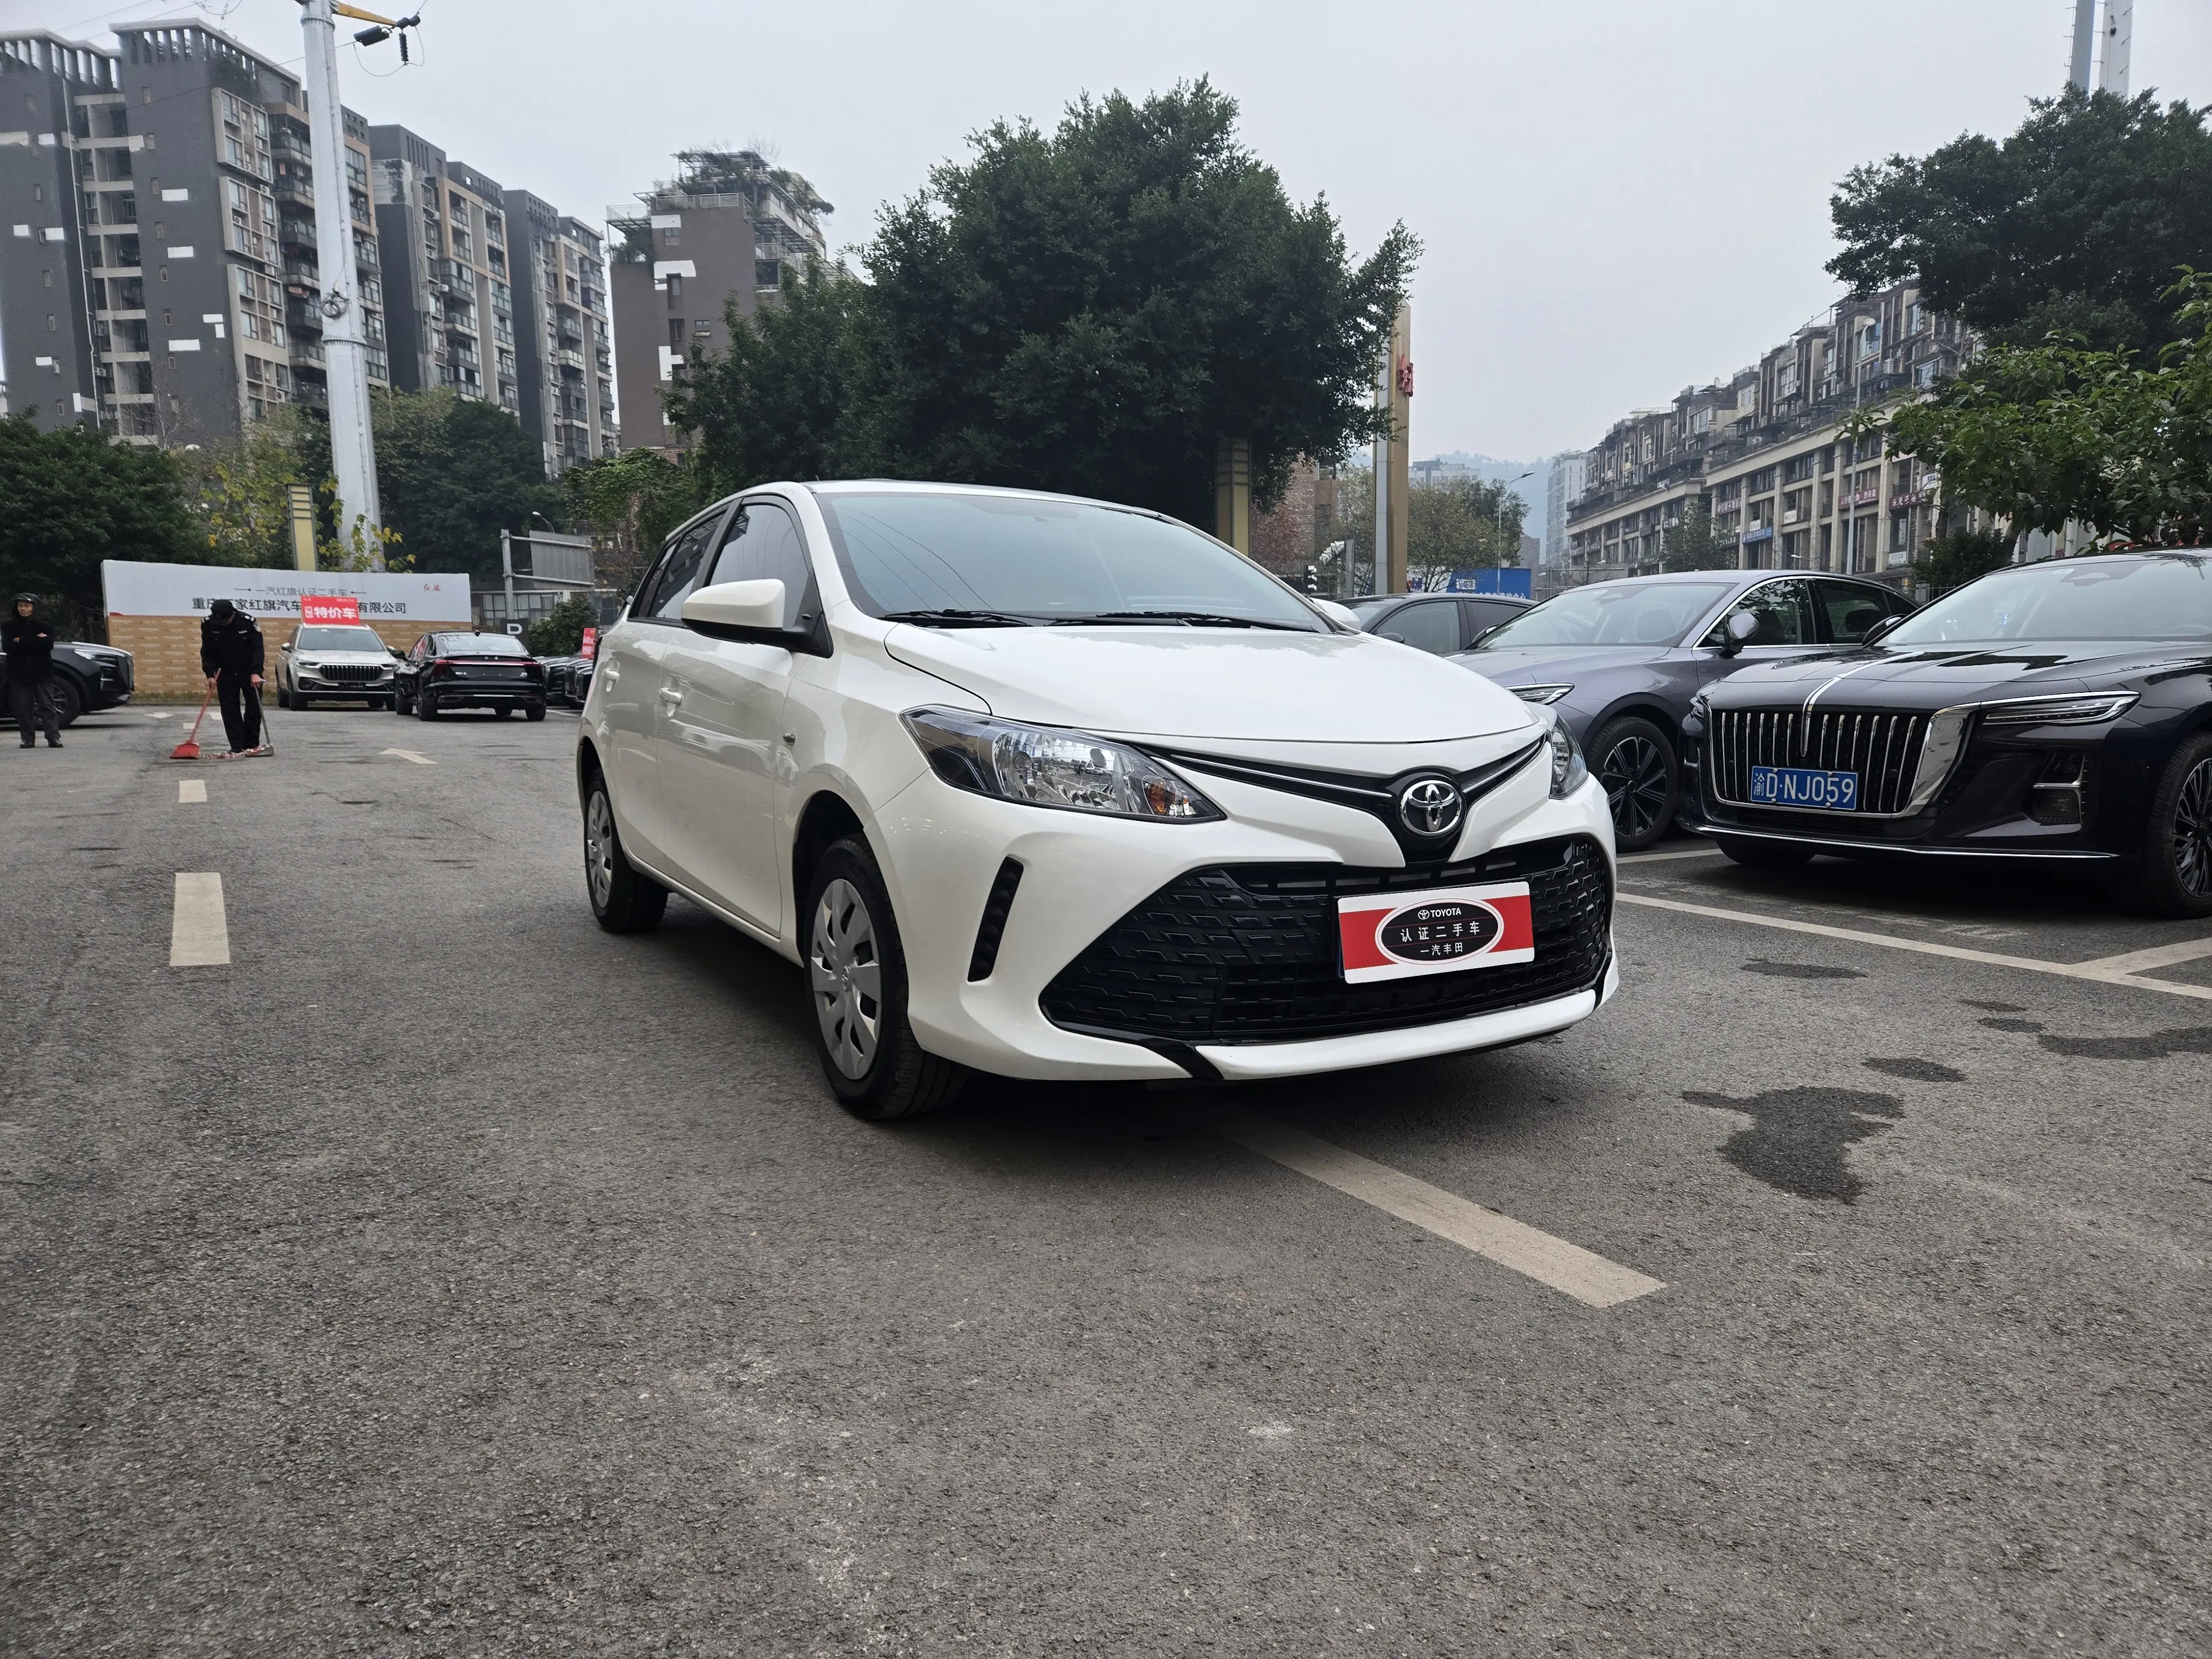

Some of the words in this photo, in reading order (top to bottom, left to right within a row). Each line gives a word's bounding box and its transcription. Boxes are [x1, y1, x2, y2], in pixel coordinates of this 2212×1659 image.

[255, 587, 348, 596] 一汽红旗认证二手车
[314, 606, 358, 619] 特价车
[1430, 907, 1462, 917] TOYOTA
[1400, 921, 1480, 942] 认证二手车
[1420, 942, 1463, 956] 一汽丰田
